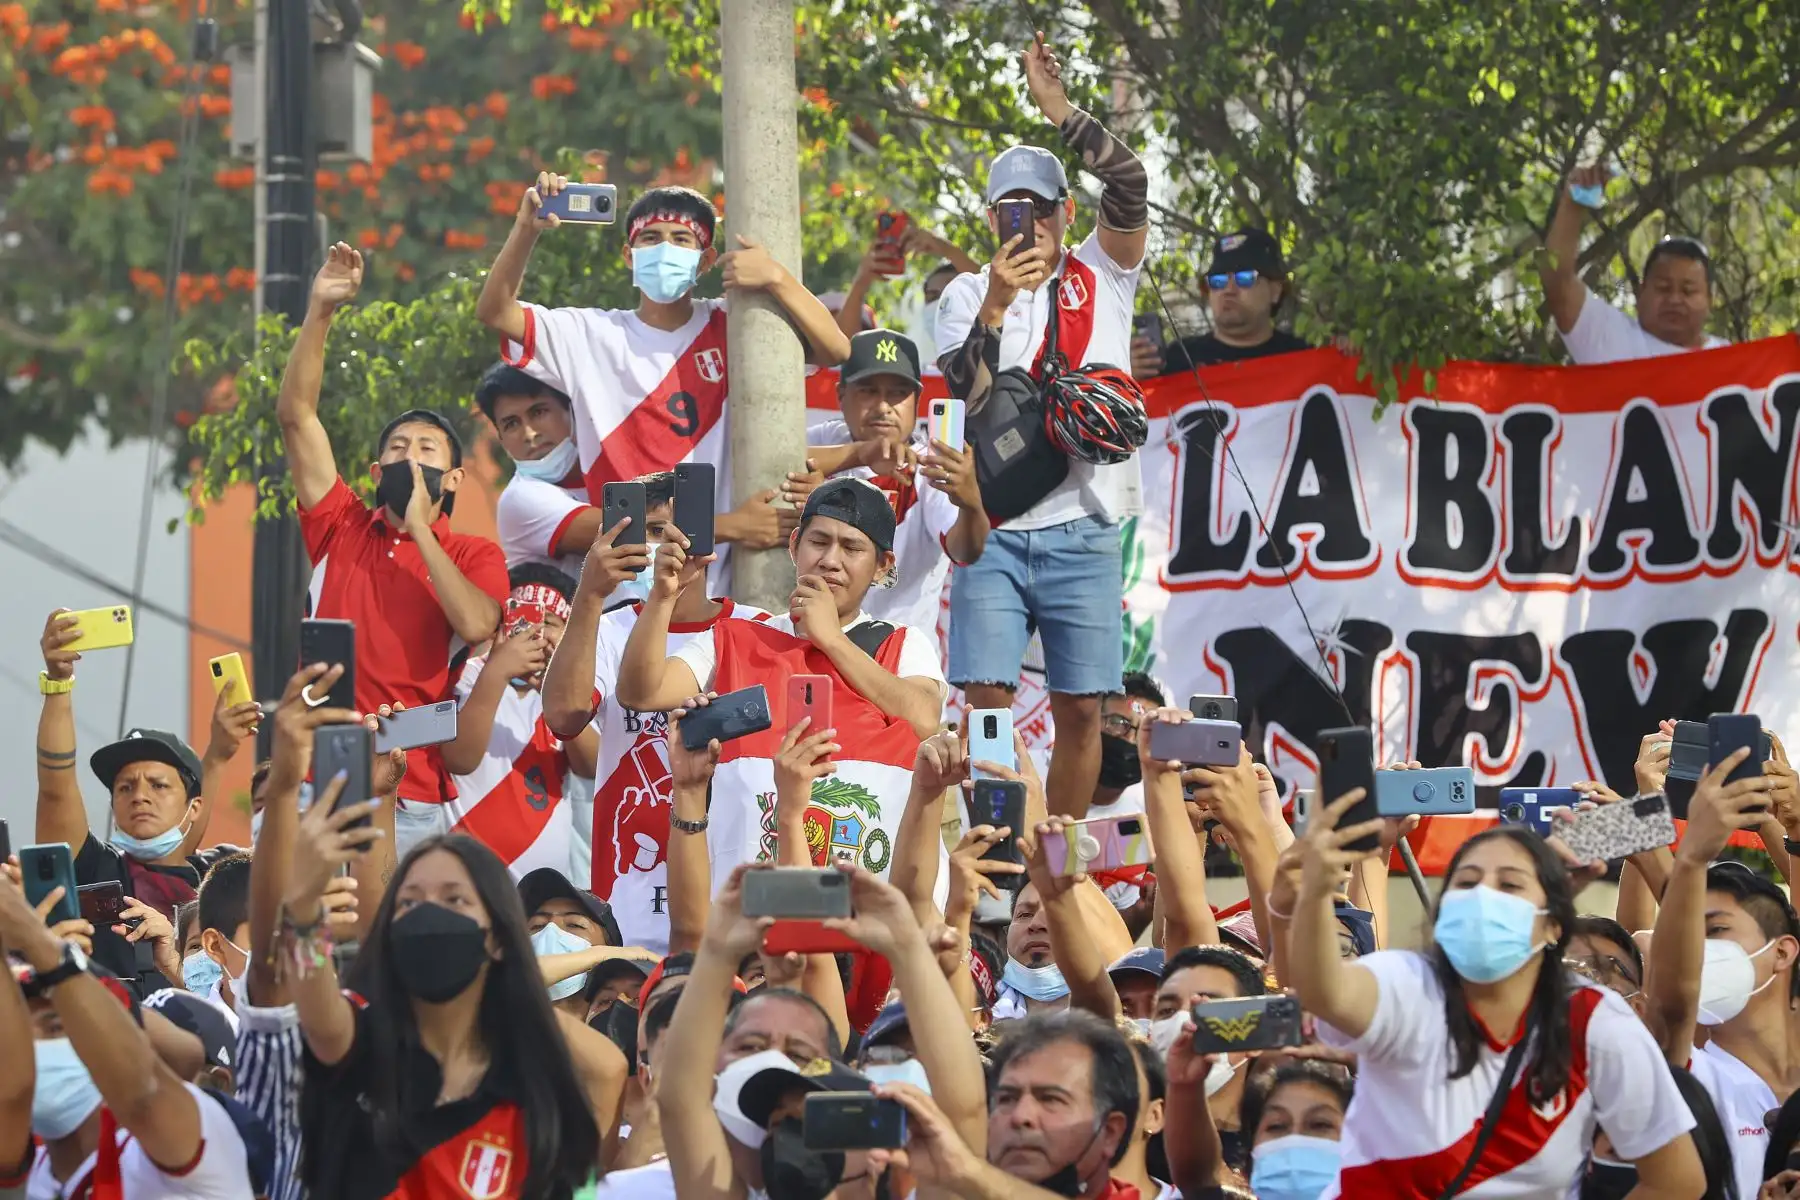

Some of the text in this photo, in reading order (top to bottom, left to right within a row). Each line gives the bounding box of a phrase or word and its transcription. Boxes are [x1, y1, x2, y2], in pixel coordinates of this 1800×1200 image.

[875, 338, 898, 363] NY
[666, 391, 700, 437] 9
[1164, 378, 1800, 579] LA BLAN
[1211, 605, 1771, 812] NEW
[523, 765, 549, 812] 9
